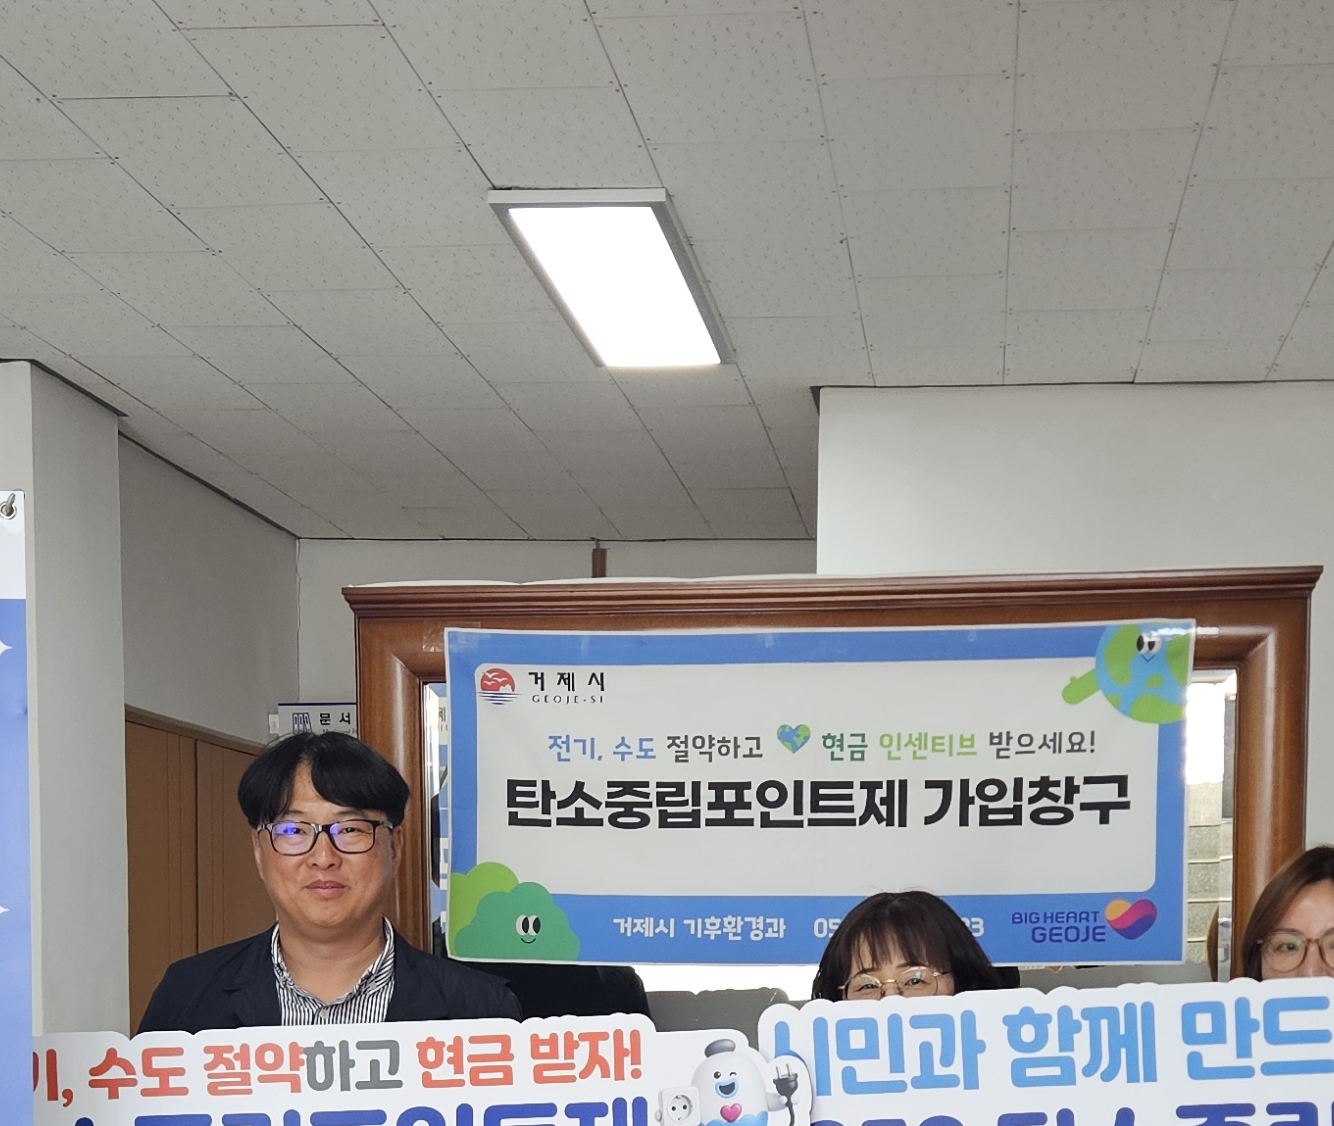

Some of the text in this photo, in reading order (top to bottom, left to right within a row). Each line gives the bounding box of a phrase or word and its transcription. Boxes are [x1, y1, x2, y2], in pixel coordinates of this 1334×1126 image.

[529, 672, 604, 691] 거제시
[532, 695, 602, 704] GEOJE-SI
[549, 731, 1094, 762] 전기, 수도 절약하고 현금 인센티브 받으세요!
[507, 775, 1130, 829] 탄소중립포인트제 가입창구
[613, 915, 786, 940] 거제시 기후환경과
[1012, 911, 1099, 924] BIG HEART
[1032, 926, 1105, 943] GEOJE
[774, 1010, 987, 1097] 시민과
[1002, 1001, 1157, 1088] 함께
[88, 1048, 188, 1100] 수도
[203, 1040, 403, 1096] 절약하고
[416, 1035, 514, 1088] 현금
[530, 1029, 642, 1084] 받자!
